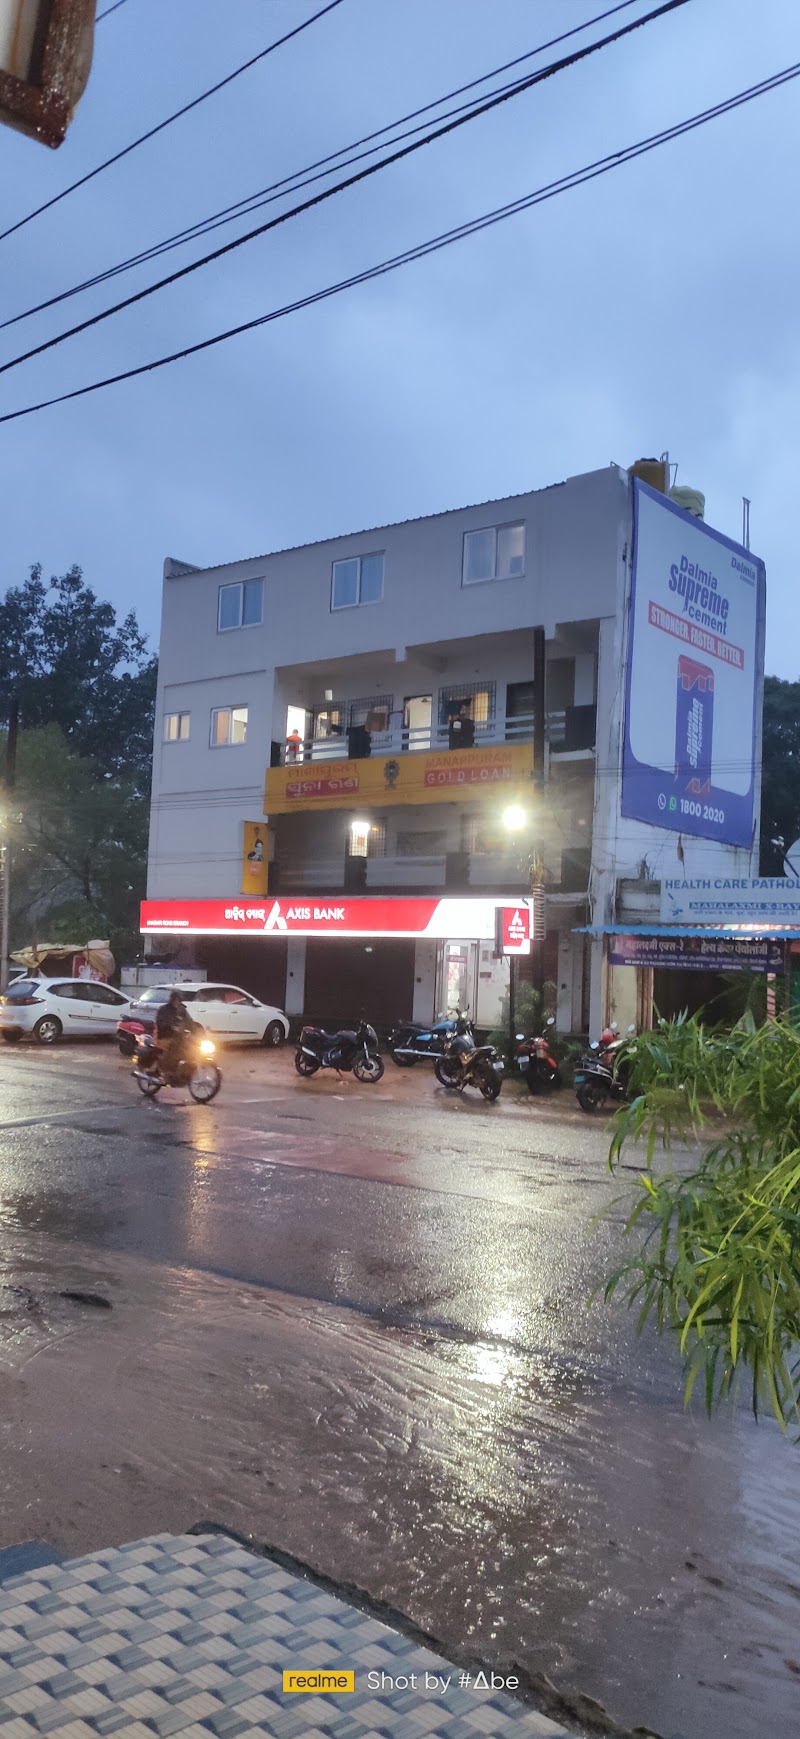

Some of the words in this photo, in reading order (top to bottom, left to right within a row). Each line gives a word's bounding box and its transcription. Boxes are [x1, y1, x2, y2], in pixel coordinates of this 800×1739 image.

[680, 554, 718, 591] Dalmia
[731, 557, 756, 580] Dalmia
[669, 563, 729, 620] Supreme
[688, 605, 727, 635] cement
[651, 606, 690, 642] STRONGER.
[690, 626, 717, 654] FASTER.
[717, 640, 742, 667] BETTER.
[425, 751, 512, 769] MANAPPURAM
[427, 770, 465, 784] GOLD
[471, 767, 511, 781] LOAN
[680, 798, 701, 818] 1800
[703, 803, 725, 824] 2020
[665, 879, 711, 889] HEALTH
[714, 879, 748, 889] CARE
[286, 907, 311, 920] AXIS
[313, 907, 345, 920] BANK
[690, 902, 762, 910] MAHALAXMI
